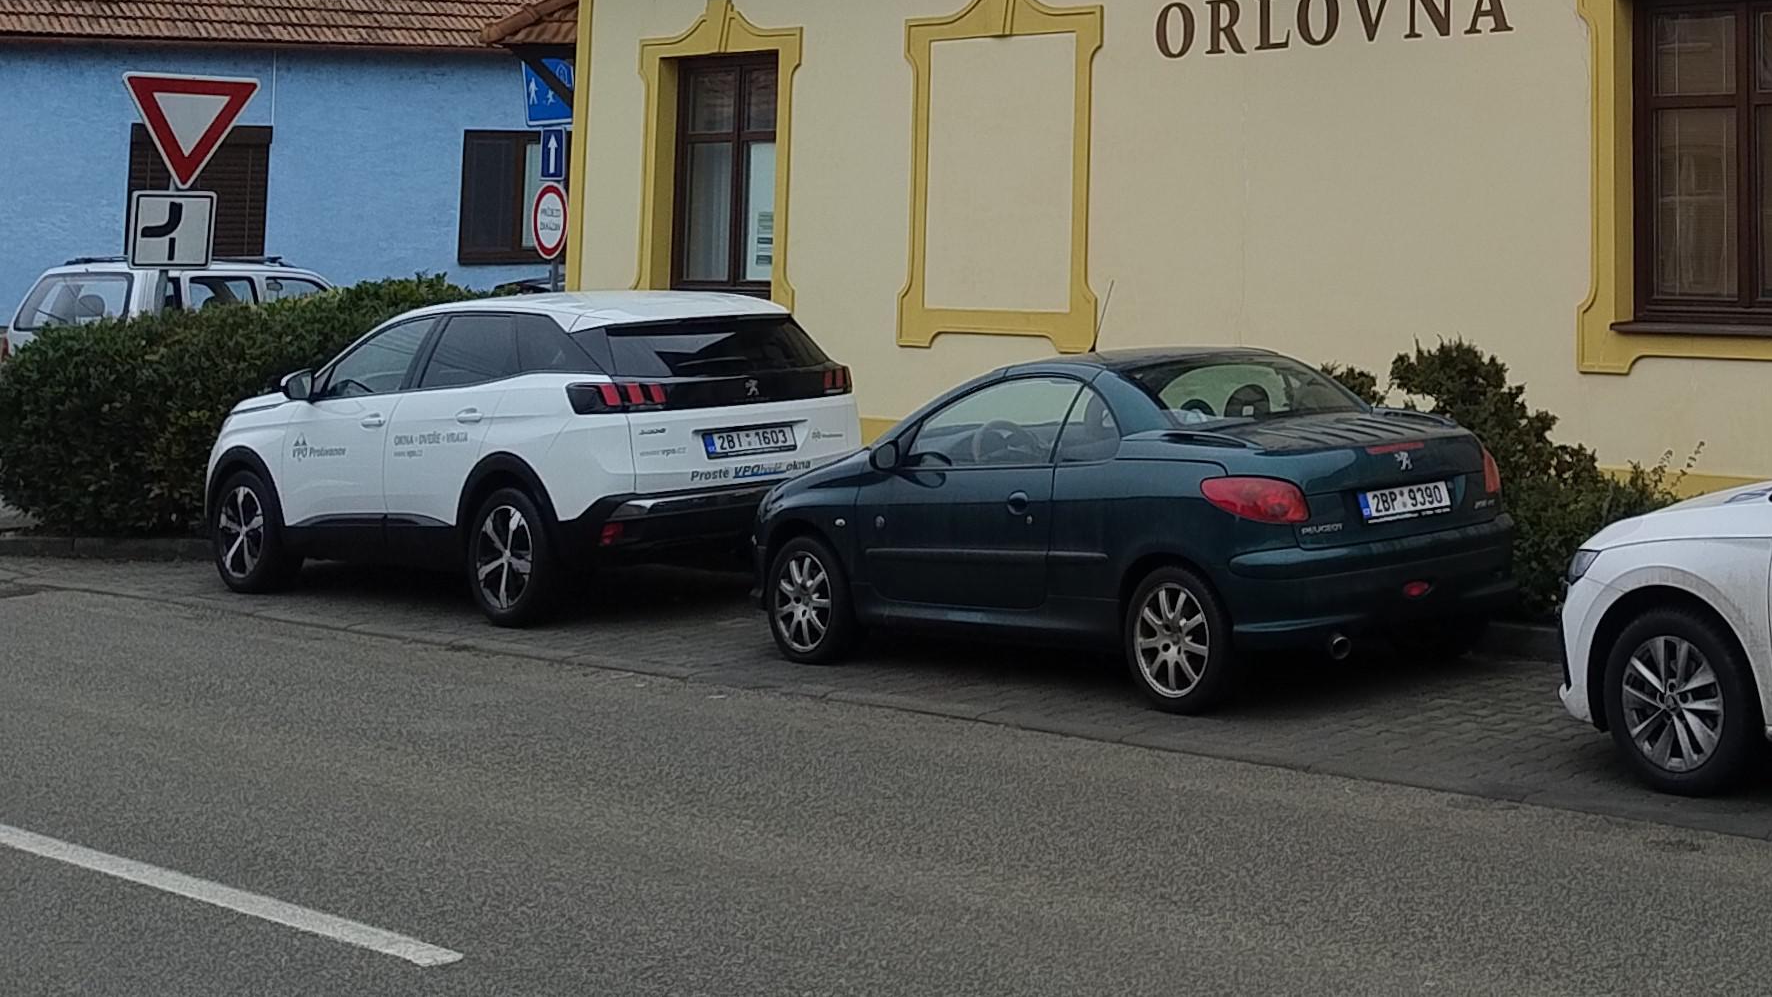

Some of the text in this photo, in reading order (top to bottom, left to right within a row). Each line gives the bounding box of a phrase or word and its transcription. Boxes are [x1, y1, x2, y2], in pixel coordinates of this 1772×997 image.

[718, 433, 742, 451] 2BI
[755, 429, 787, 446] 1603
[786, 460, 811, 471] okna
[1372, 484, 1444, 513] 2BP 9390
[1301, 523, 1343, 535] PEUGEOT
